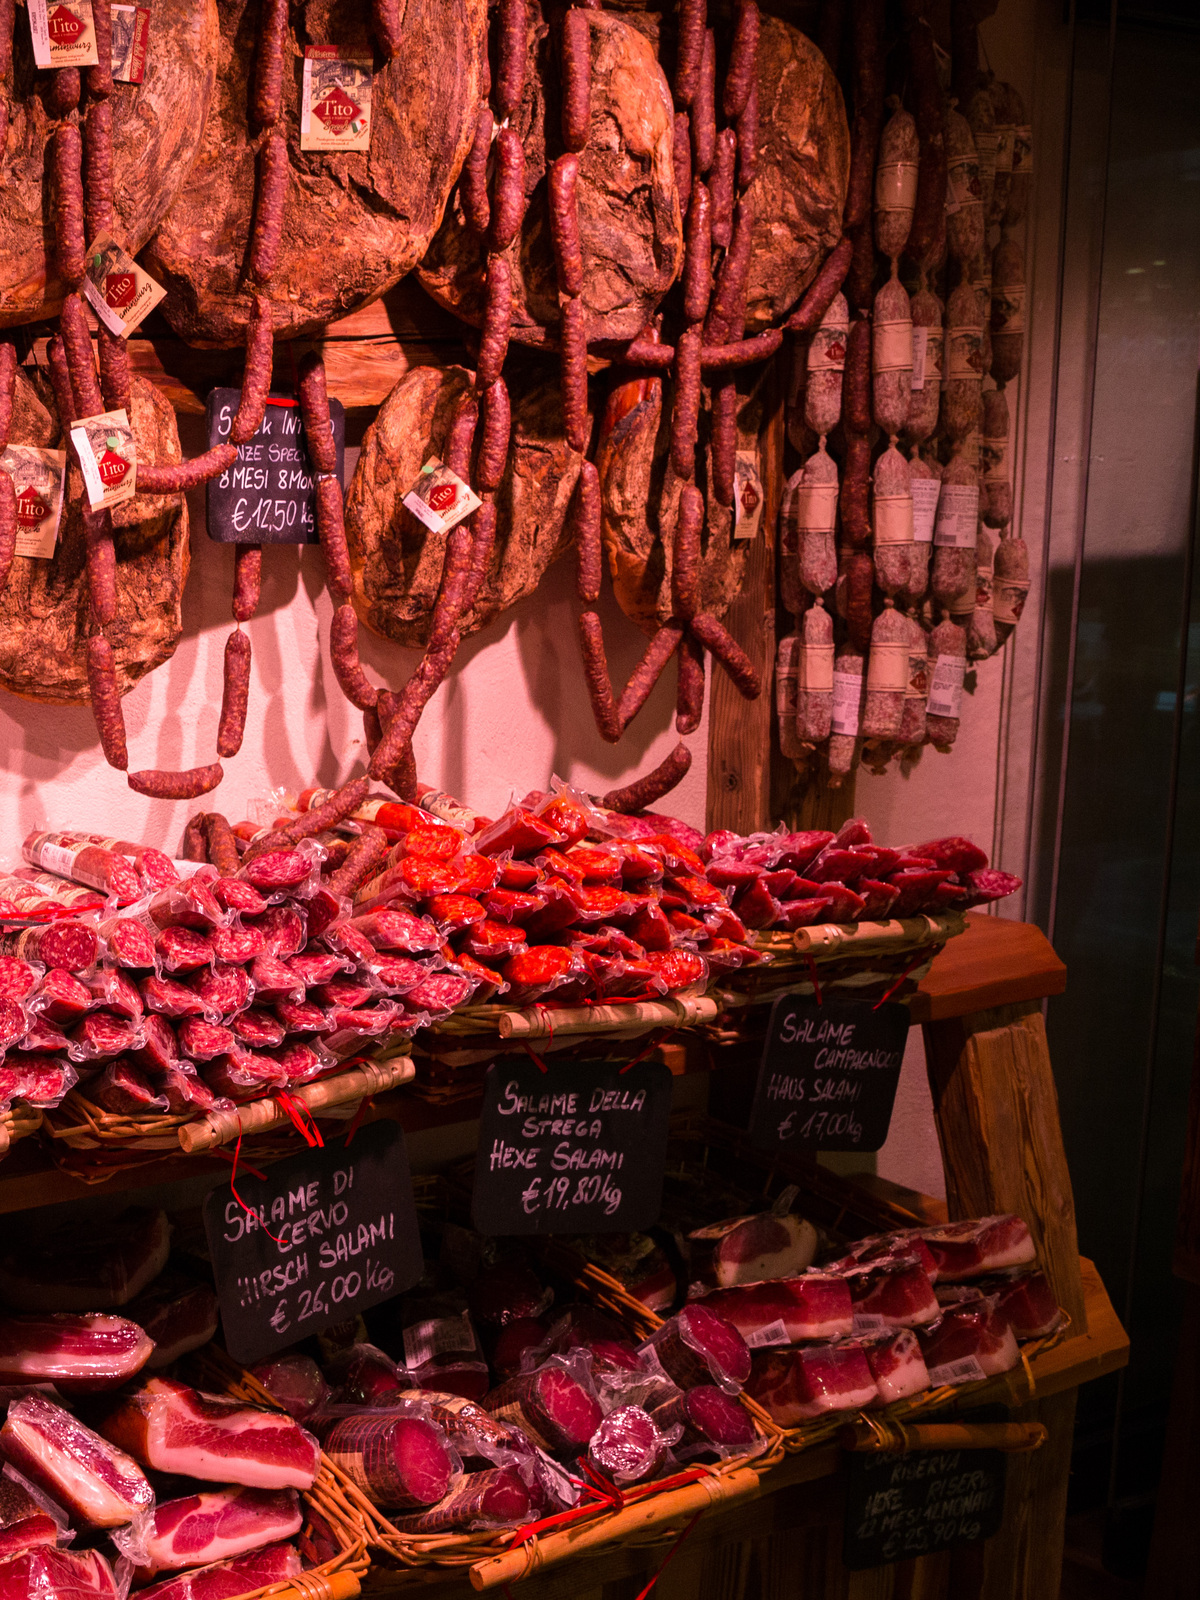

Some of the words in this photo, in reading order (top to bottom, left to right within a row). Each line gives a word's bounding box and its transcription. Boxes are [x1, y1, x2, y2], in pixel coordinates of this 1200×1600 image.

[50, 18, 79, 34] Tito
[321, 100, 353, 116] Tito
[323, 119, 349, 134] Speck
[108, 277, 132, 301] Tito
[98, 461, 125, 477] Tito
[431, 487, 453, 506] Tito
[779, 1013, 856, 1046] SALAME
[498, 1081, 579, 1115] SALAME
[588, 1087, 647, 1112] DELLA
[809, 1078, 863, 1103] SALAMI
[521, 1116, 602, 1139] STREGA
[490, 1138, 541, 1171] HEXE
[550, 1142, 624, 1171] SALAMI
[224, 1181, 319, 1242] SALAME
[333, 1166, 353, 1196] DI
[276, 1201, 348, 1253] CERVO
[318, 1213, 394, 1268] SALAMI
